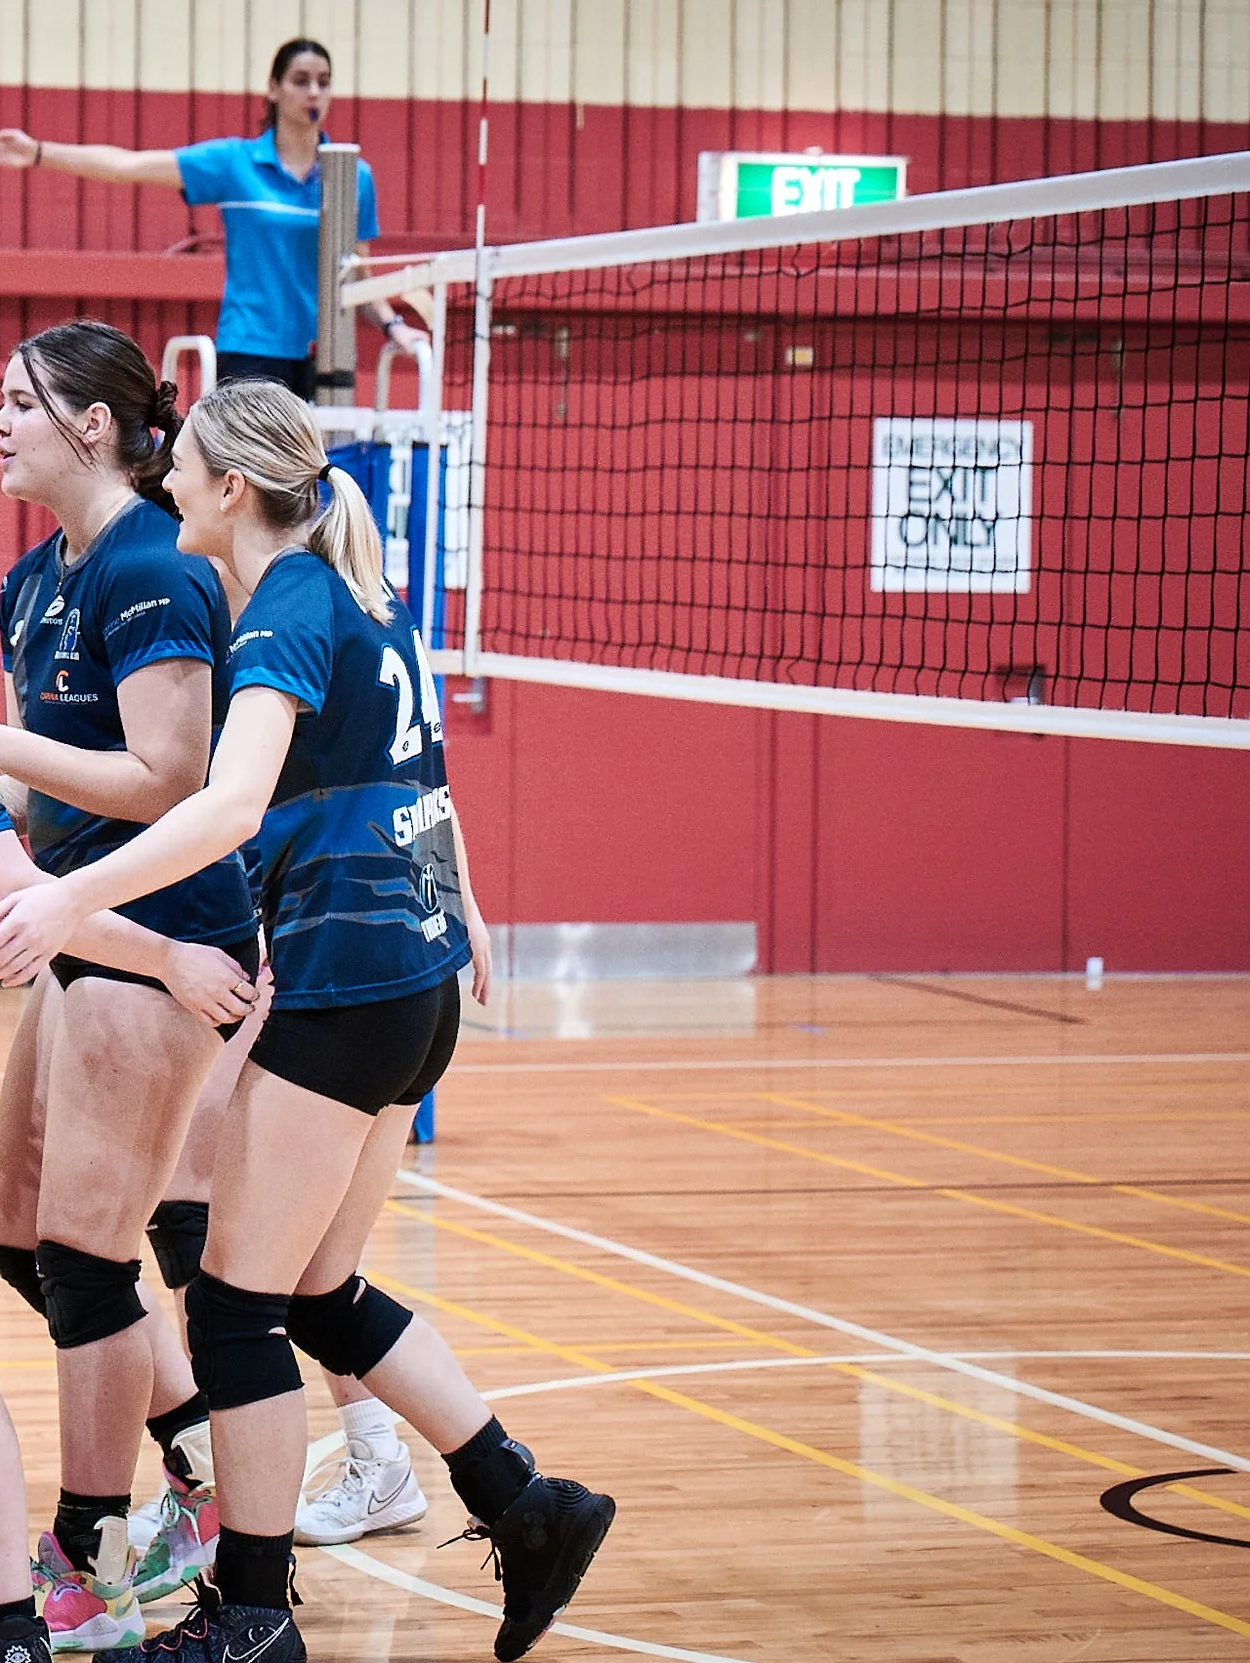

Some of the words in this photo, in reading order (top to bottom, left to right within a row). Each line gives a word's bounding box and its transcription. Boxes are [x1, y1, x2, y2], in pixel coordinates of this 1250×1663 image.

[771, 166, 862, 217] EXIT
[908, 465, 998, 503] EXIT
[899, 512, 996, 547] ONLY
